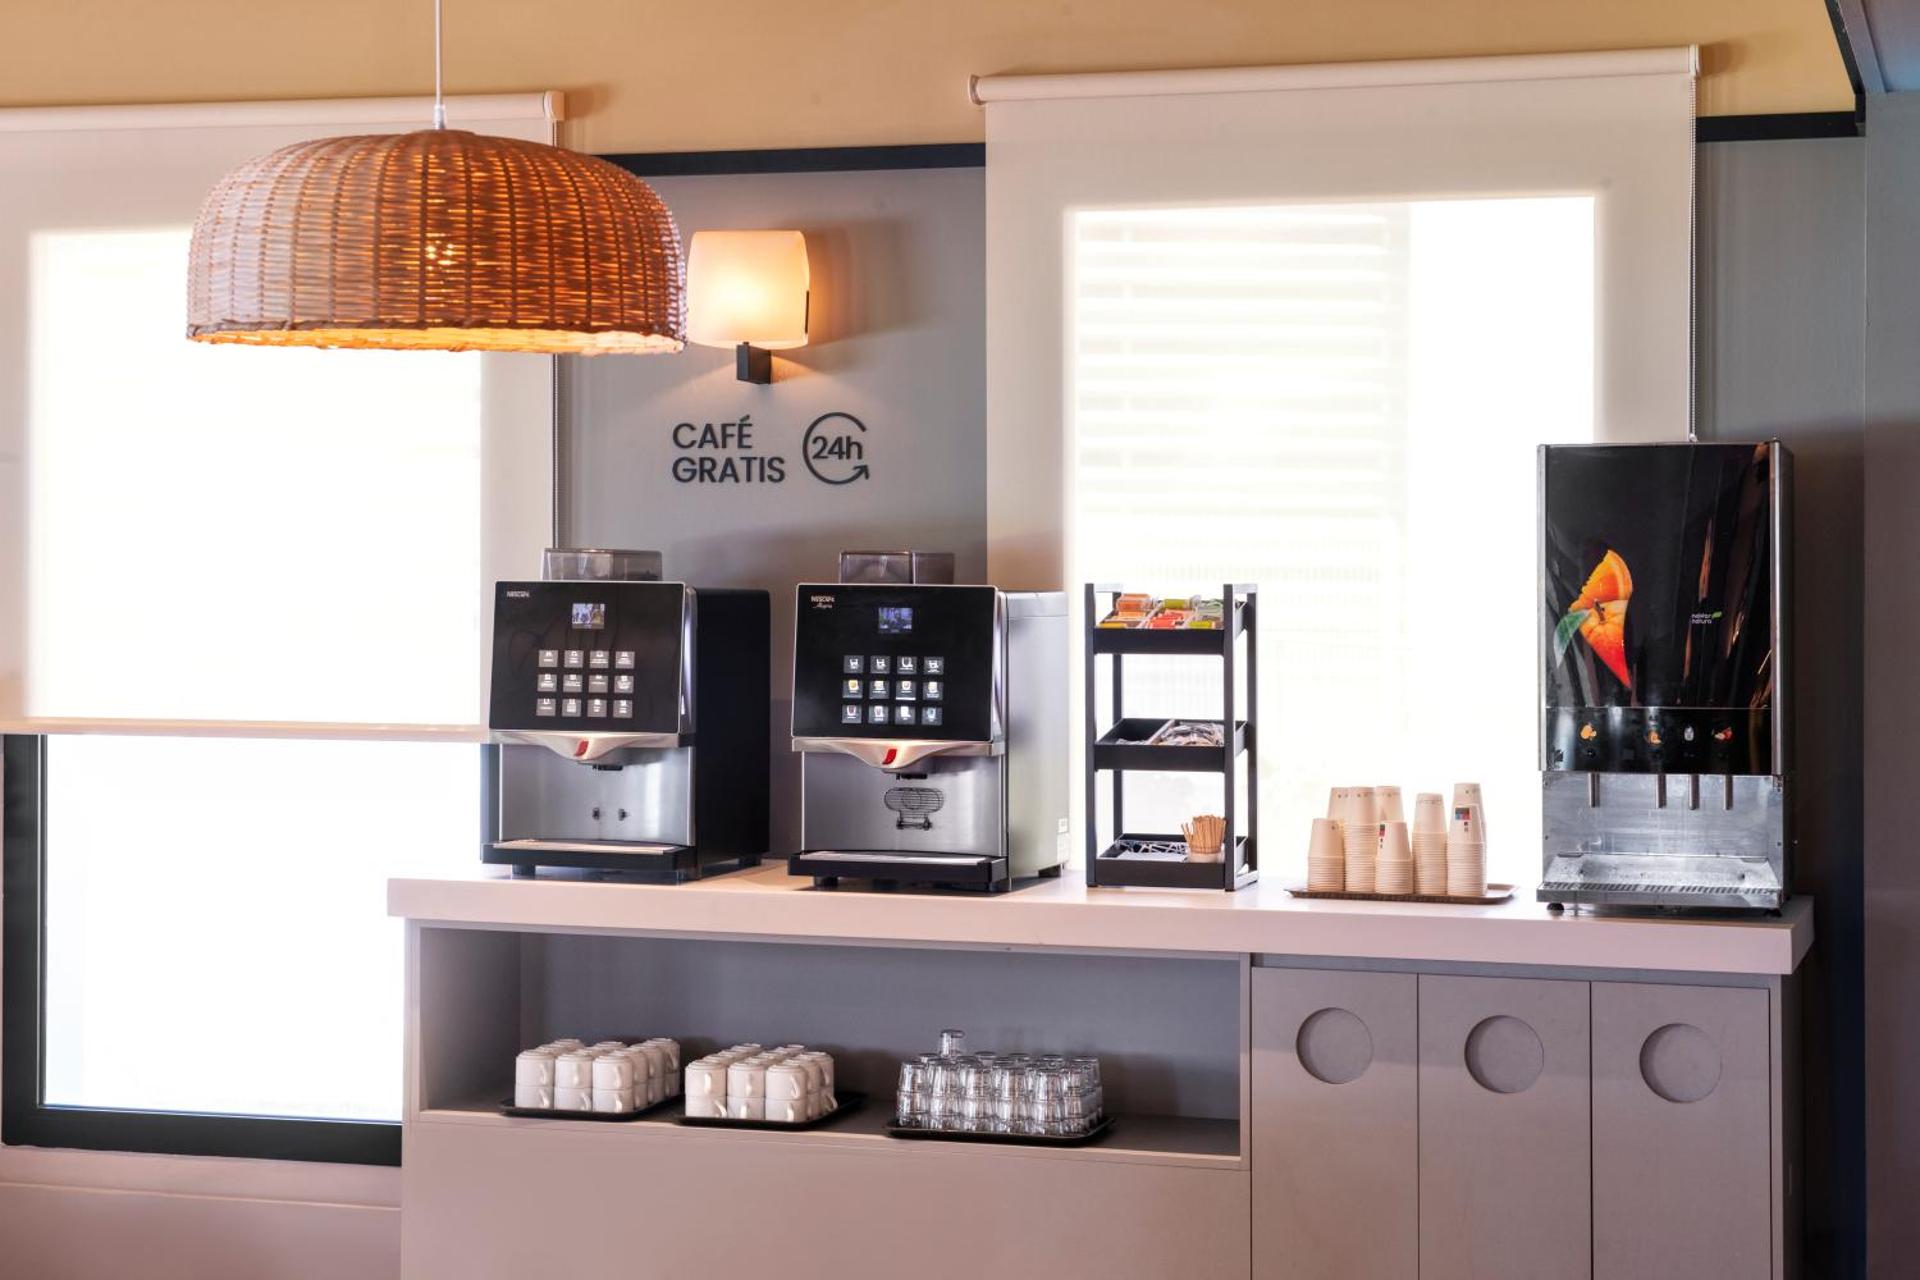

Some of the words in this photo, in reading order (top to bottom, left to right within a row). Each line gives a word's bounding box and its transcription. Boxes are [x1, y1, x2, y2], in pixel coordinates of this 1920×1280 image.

[672, 414, 753, 449] CAFÉ
[811, 435, 864, 460] 24h
[672, 456, 786, 483] GRATIS
